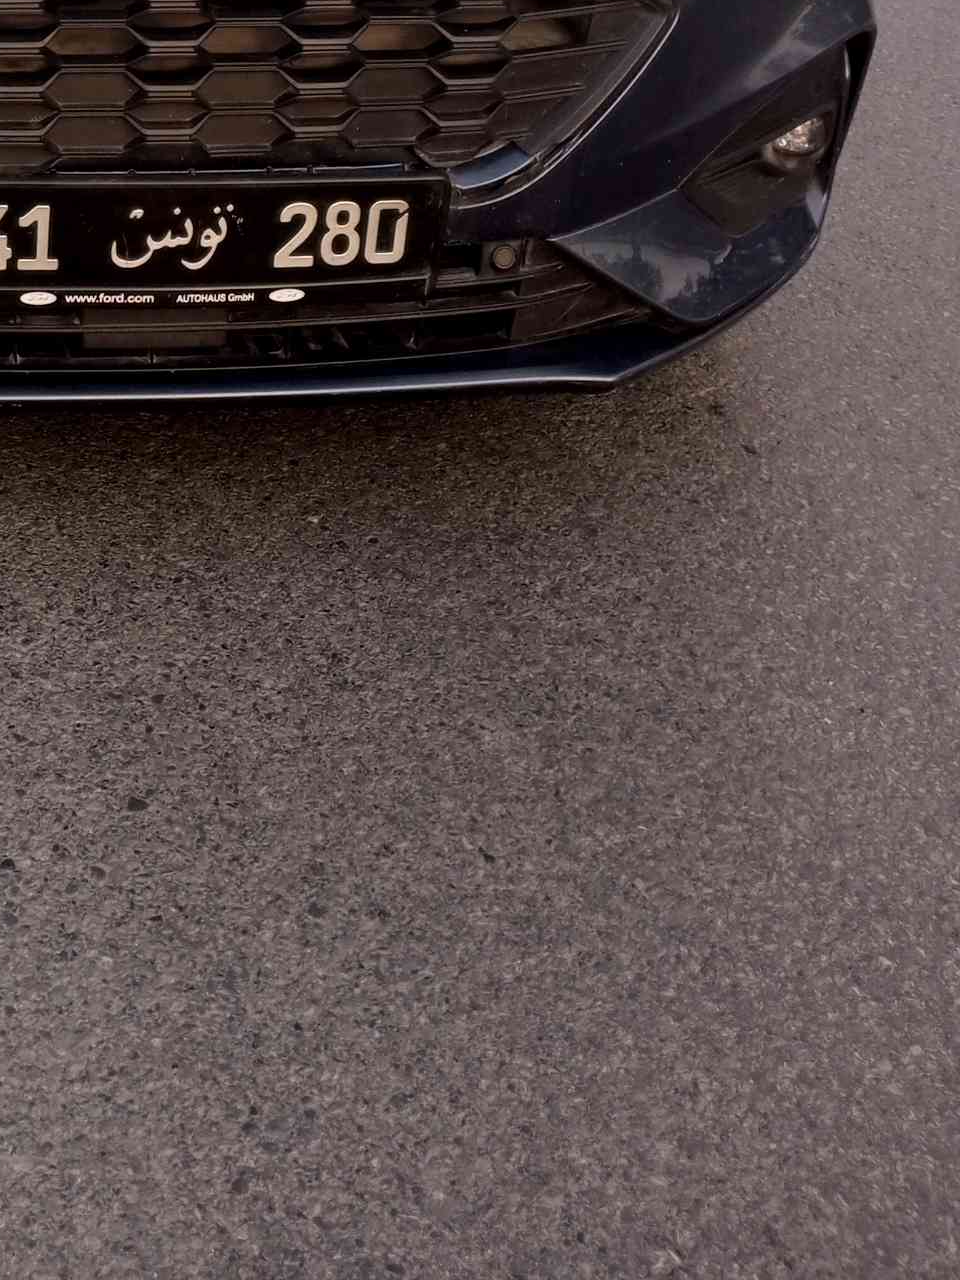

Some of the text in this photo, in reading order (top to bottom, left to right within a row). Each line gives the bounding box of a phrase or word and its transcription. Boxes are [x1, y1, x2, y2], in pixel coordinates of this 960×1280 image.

[110, 204, 235, 270] تونس
[273, 200, 409, 269] 280
[64, 292, 156, 304] www.ford.com
[175, 293, 227, 304] AUTOHAUS
[227, 292, 255, 303] GmbH
